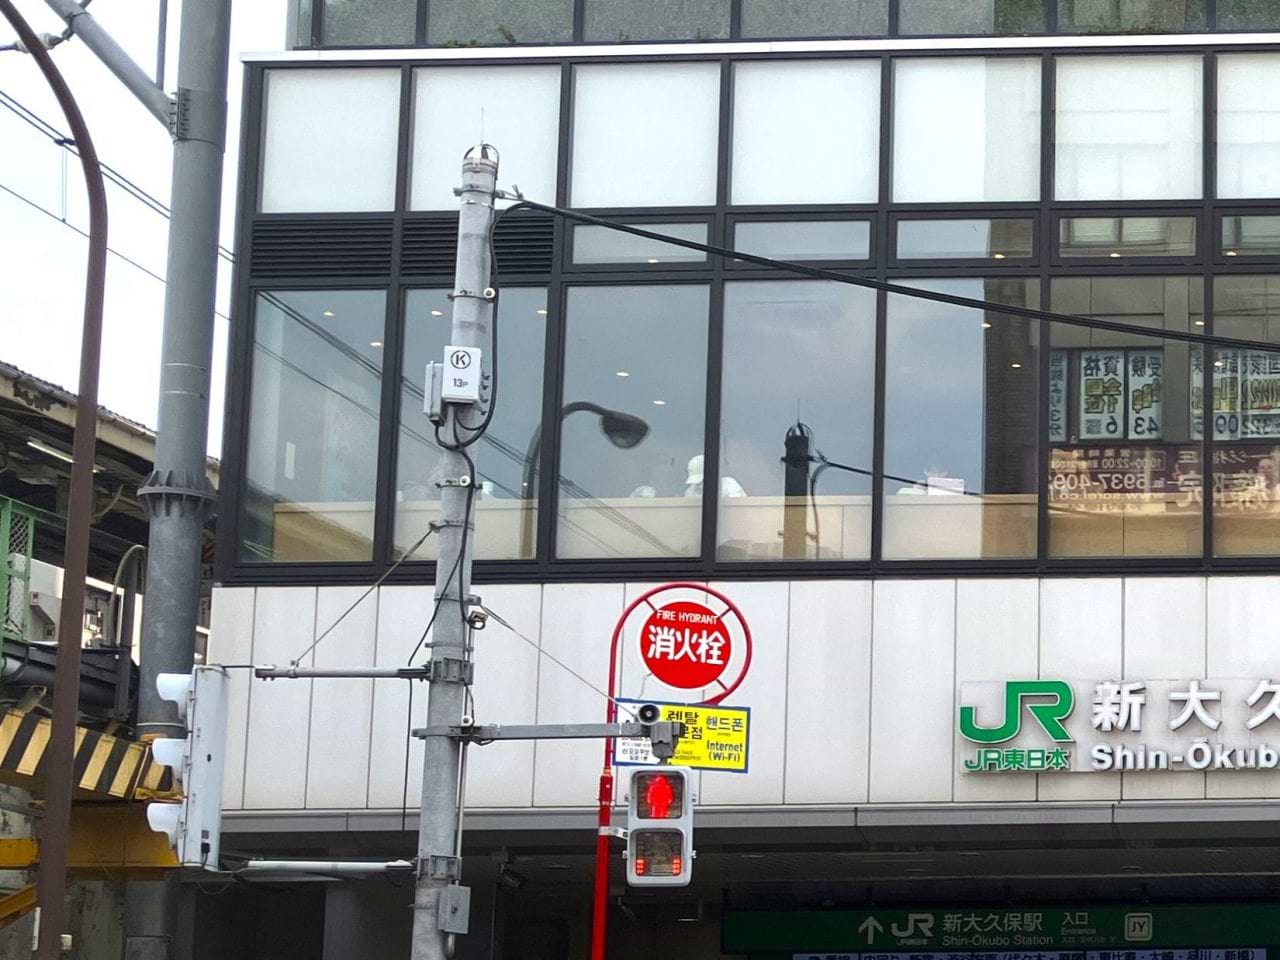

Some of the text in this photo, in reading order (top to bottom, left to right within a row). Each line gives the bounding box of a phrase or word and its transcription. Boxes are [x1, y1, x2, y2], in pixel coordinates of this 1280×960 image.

[656, 610, 719, 625] FIRE HYDRANT
[648, 625, 726, 665] 消火栓
[960, 680, 1075, 743] JR
[707, 740, 743, 753] Internet
[708, 751, 741, 762] (Wi-Fi)
[963, 746, 1071, 772] JR東日本
[891, 912, 935, 937] JR
[942, 912, 1043, 932] 新大久保駅
[1061, 912, 1088, 925] 入口
[1013, 934, 1054, 946] Station
